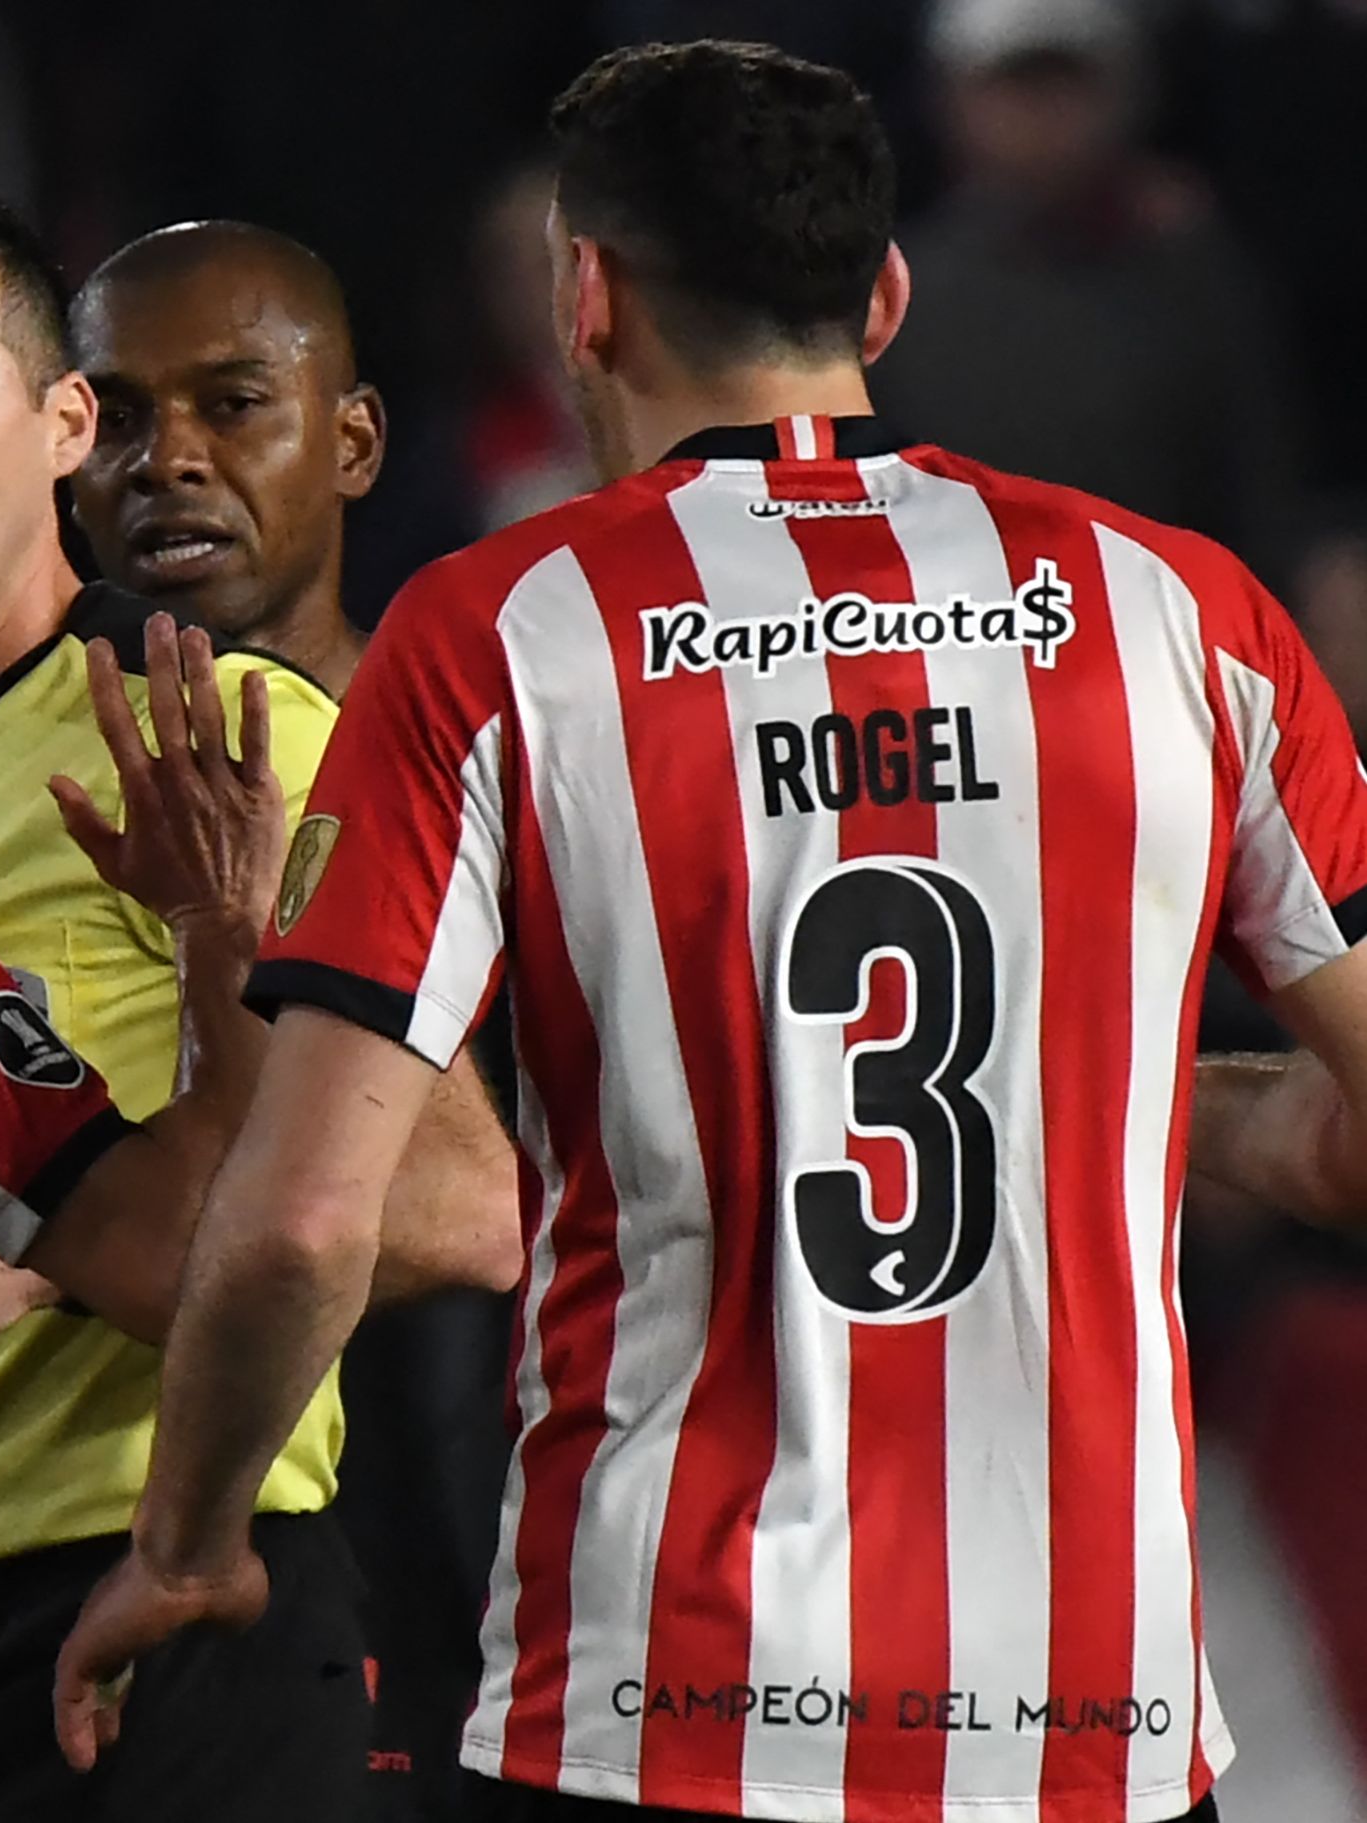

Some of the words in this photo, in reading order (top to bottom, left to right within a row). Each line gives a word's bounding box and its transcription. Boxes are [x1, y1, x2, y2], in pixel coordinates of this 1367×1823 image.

[643, 562, 1072, 677] RapiCuota$
[754, 705, 999, 817] ROGEL
[780, 855, 1001, 1324] 3
[611, 1675, 869, 1728] CAMPEÓN
[897, 1689, 992, 1732] DEL
[1014, 1695, 1172, 1737] MUNDO
